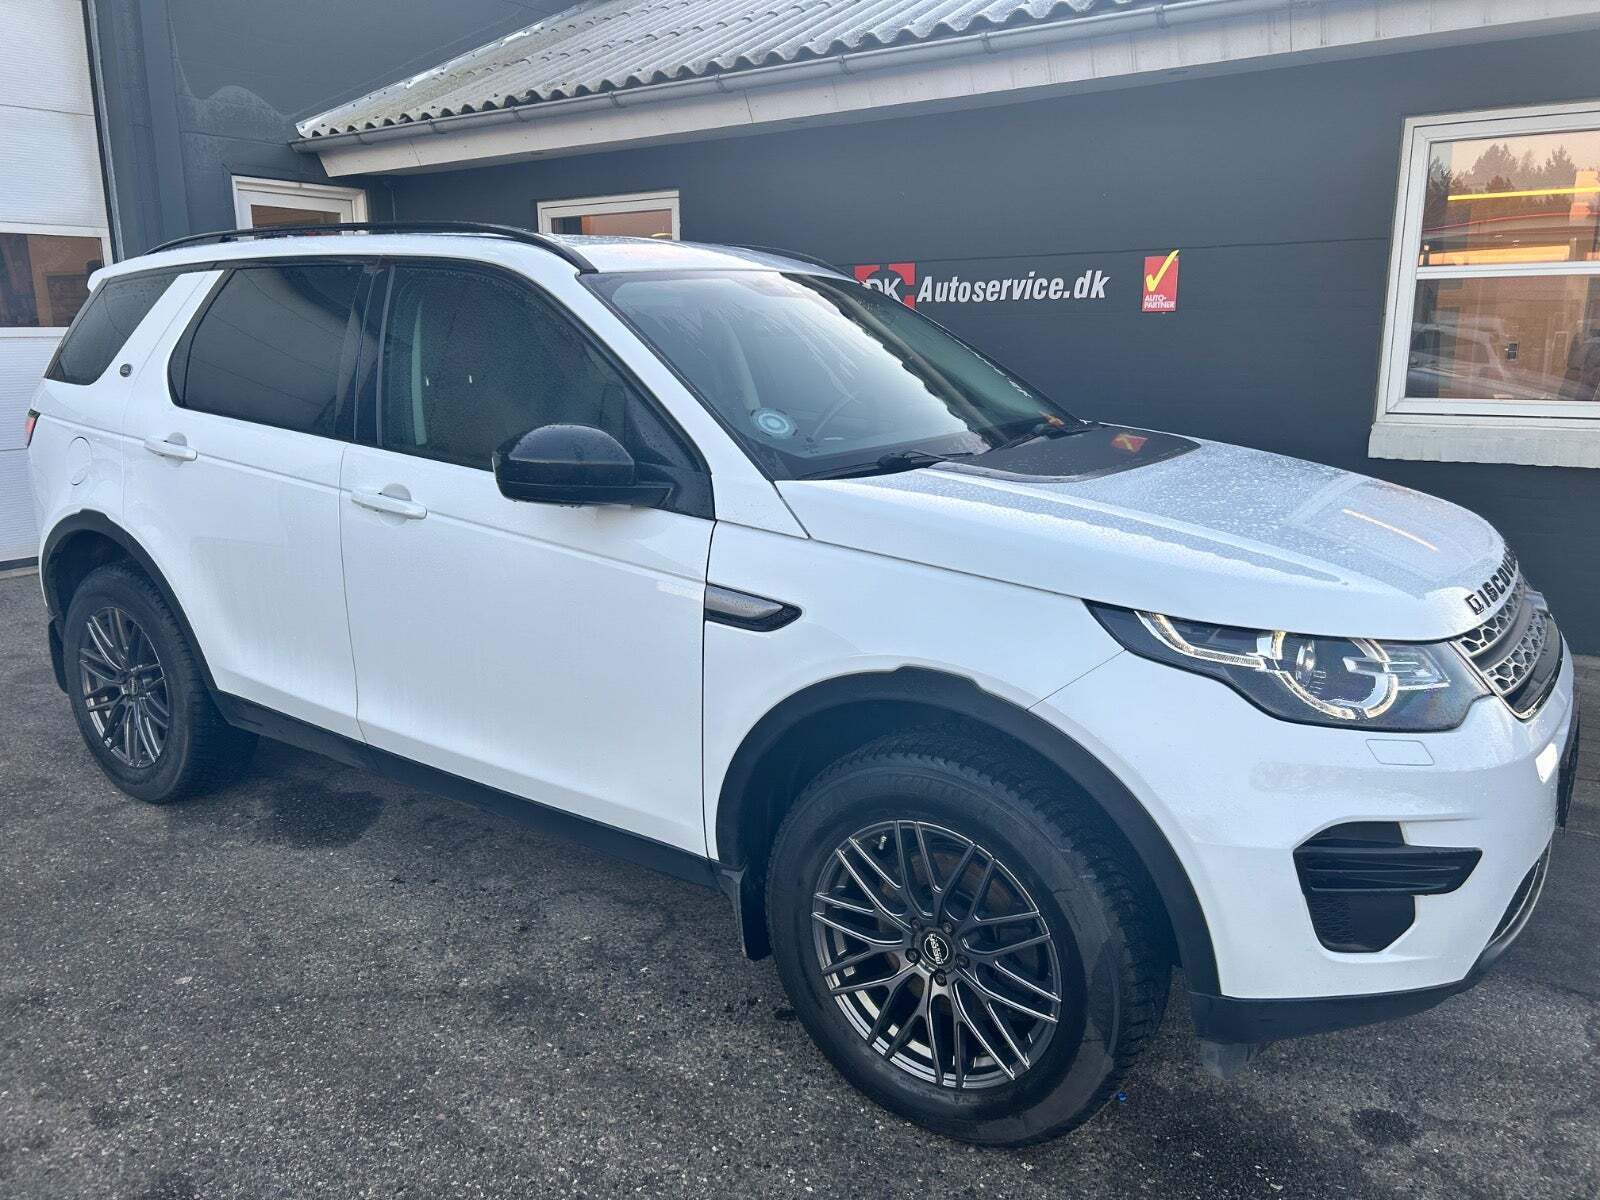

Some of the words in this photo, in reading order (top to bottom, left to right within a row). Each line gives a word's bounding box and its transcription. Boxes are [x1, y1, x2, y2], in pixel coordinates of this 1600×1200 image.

[917, 270, 1109, 303] Autoservice.dk
[1144, 294, 1167, 302] AUTO-
[1144, 300, 1175, 309] PARTNER
[1465, 547, 1518, 616] DISCOV
